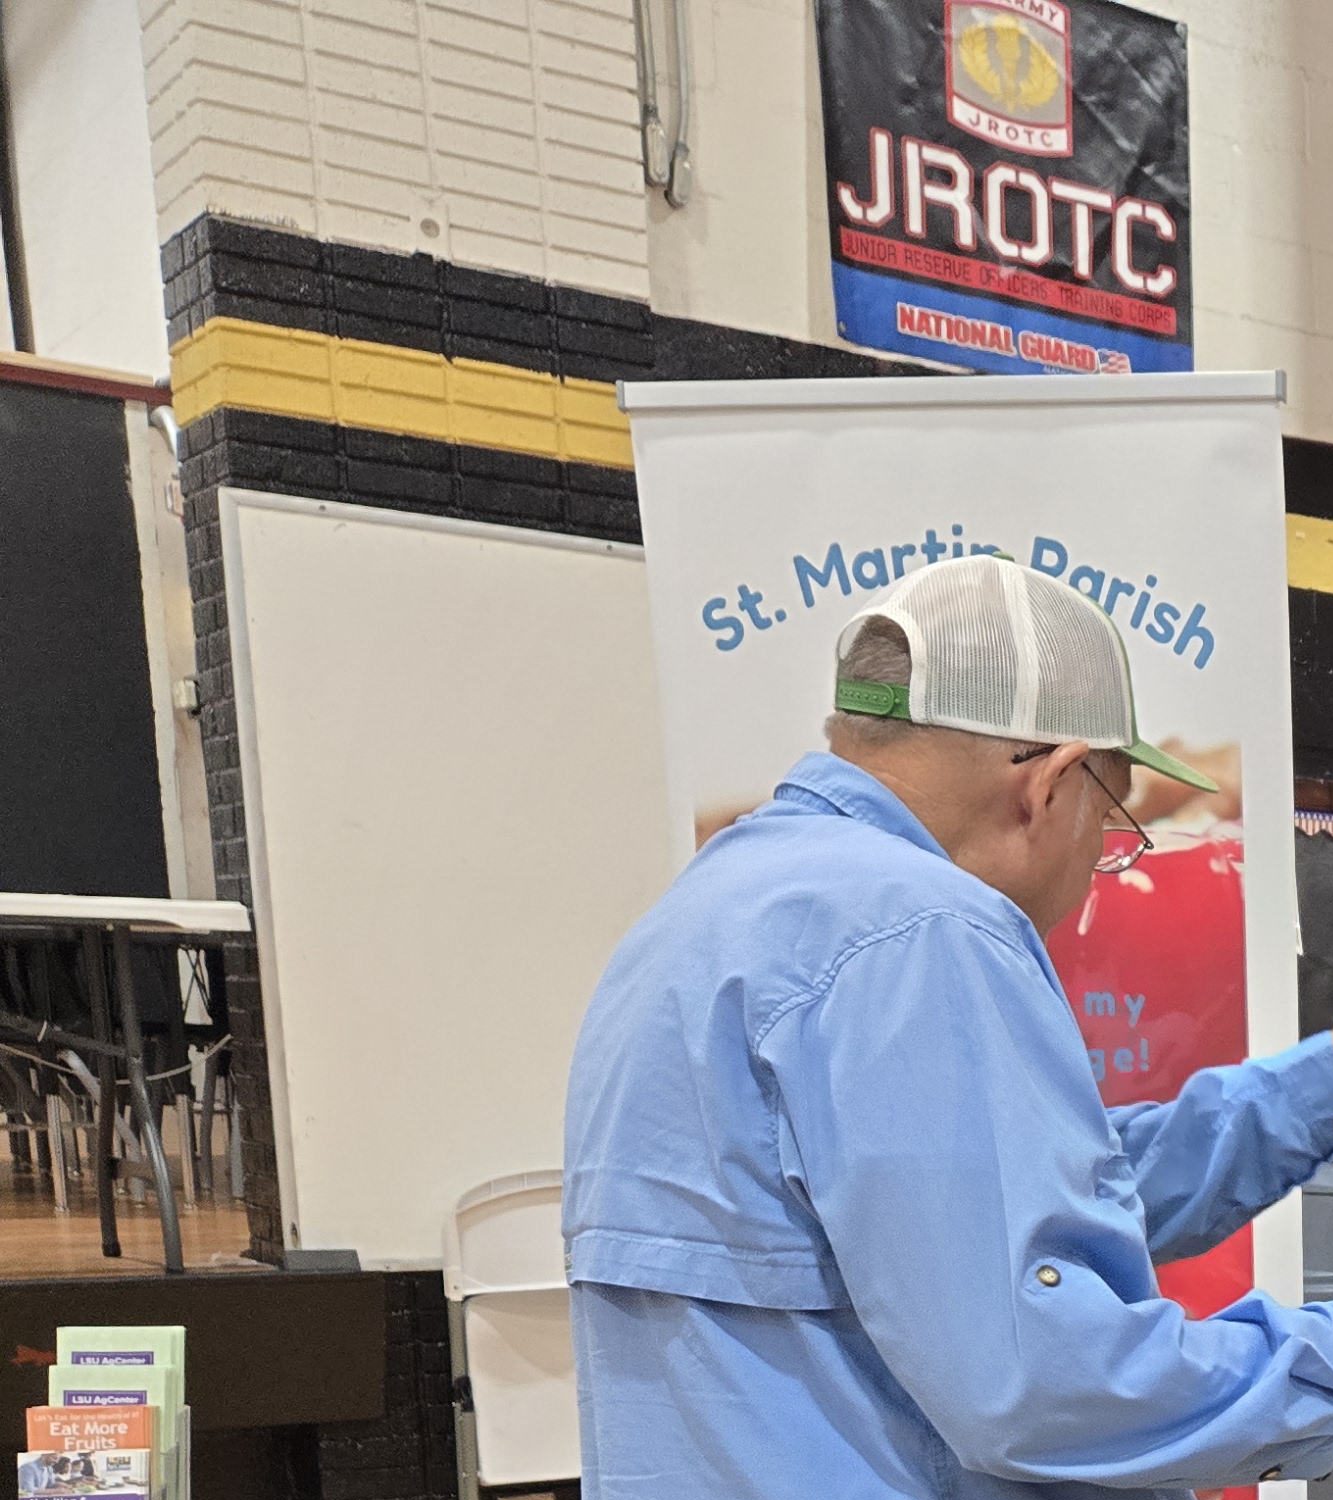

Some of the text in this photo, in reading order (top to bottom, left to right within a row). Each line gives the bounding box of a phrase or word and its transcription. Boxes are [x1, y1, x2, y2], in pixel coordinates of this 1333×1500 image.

[967, 112, 1054, 148] JROTC
[837, 126, 1177, 297] JROTC
[845, 234, 897, 265] JUNIOR
[905, 247, 971, 282] RESERVE
[1060, 286, 1121, 318] TRAINING
[1130, 302, 1171, 329] CORPS
[898, 302, 1098, 373] NATIONAL GUARD
[702, 523, 1215, 670] St. Marti Parish
[1083, 990, 1145, 1027] my
[72, 1395, 92, 1404] LSU
[50, 1421, 128, 1436] Eat More
[64, 1436, 116, 1450] Fruits
